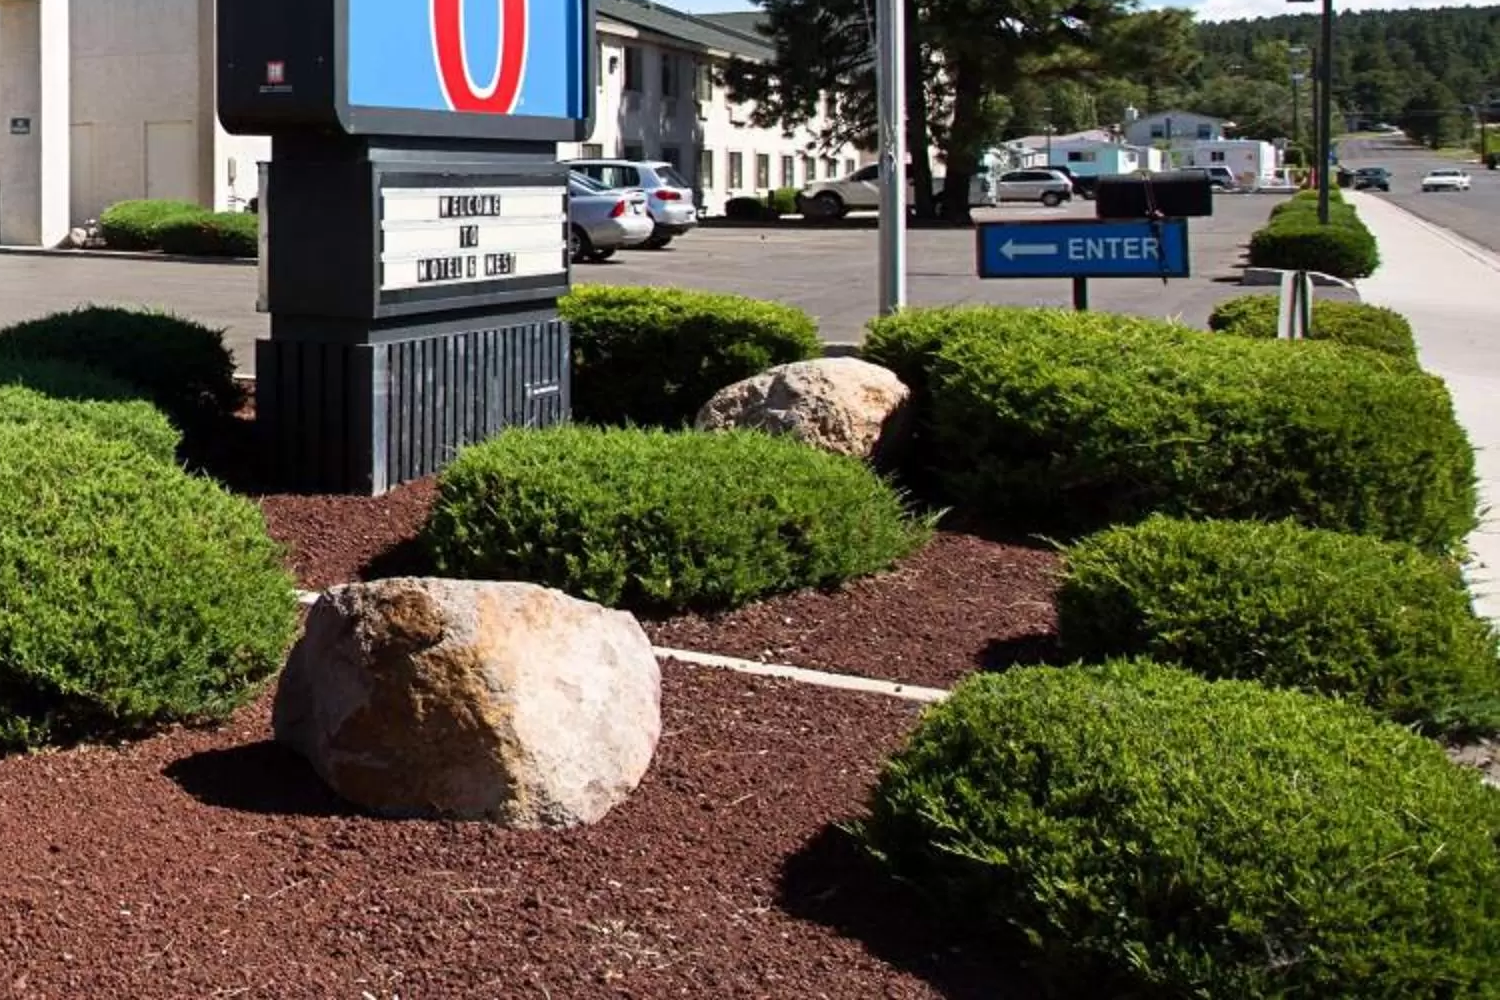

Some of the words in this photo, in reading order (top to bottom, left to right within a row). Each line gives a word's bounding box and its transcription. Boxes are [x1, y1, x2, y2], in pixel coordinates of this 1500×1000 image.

[440, 195, 501, 217] WELCOME
[460, 226, 478, 247] TO
[1068, 237, 1158, 259] ENTER
[418, 257, 462, 281] MOTEL
